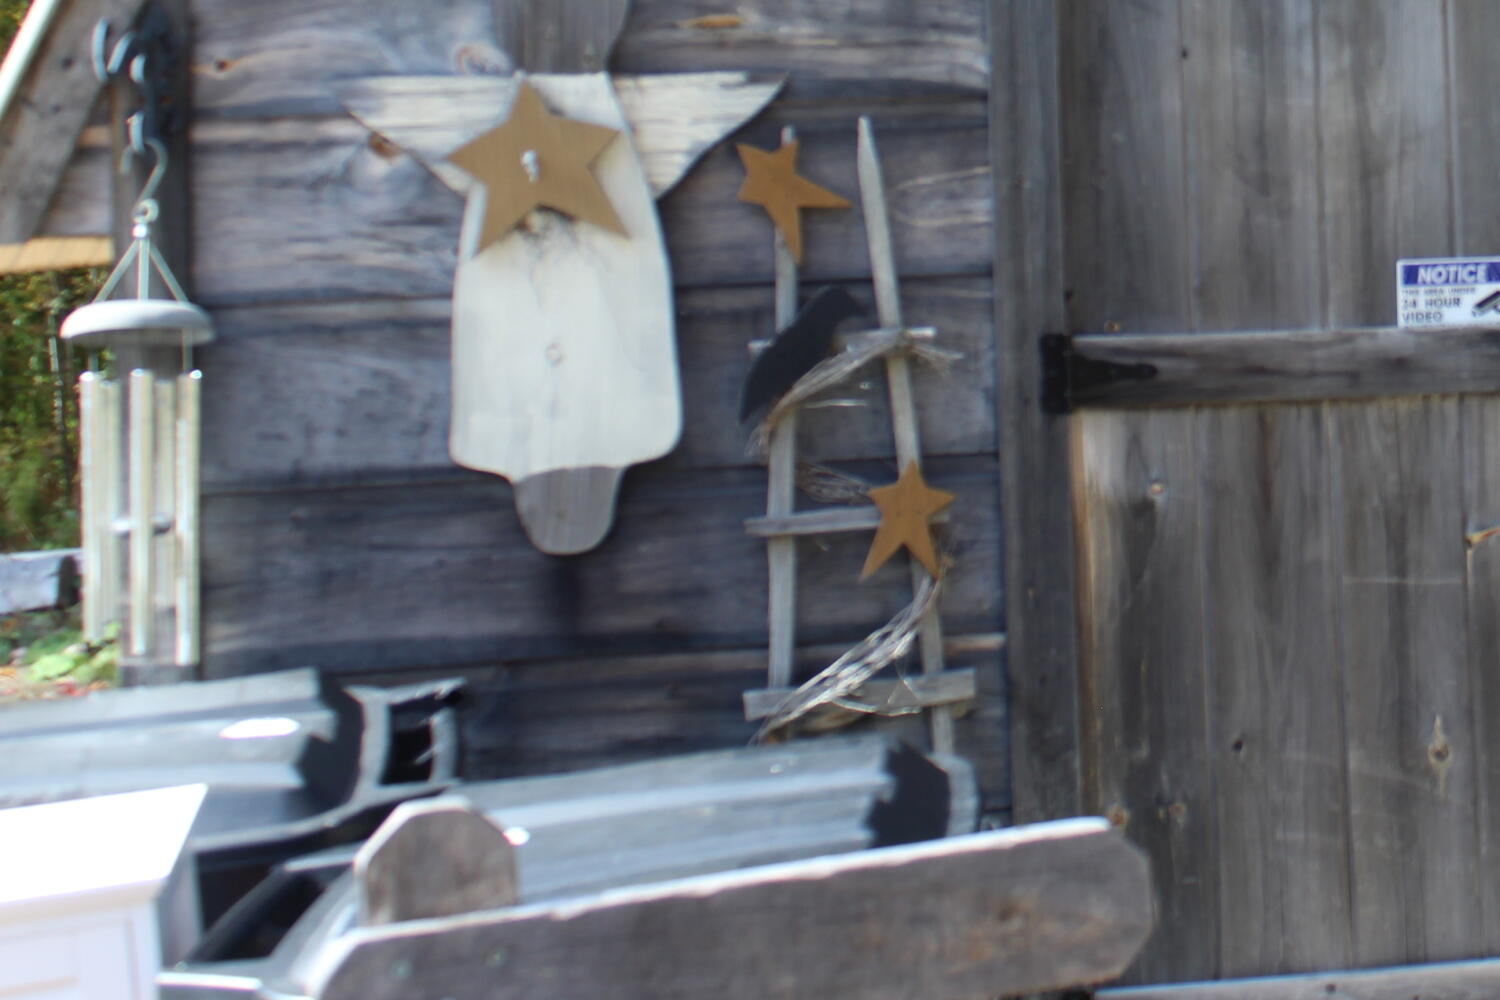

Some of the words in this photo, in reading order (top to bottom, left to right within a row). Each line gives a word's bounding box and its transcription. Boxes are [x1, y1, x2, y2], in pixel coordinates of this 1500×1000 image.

[1417, 264, 1487, 286] NOTICE
[1403, 298, 1417, 309] 24
[1424, 297, 1461, 309] HOUR
[1402, 311, 1443, 323] VIDEO
